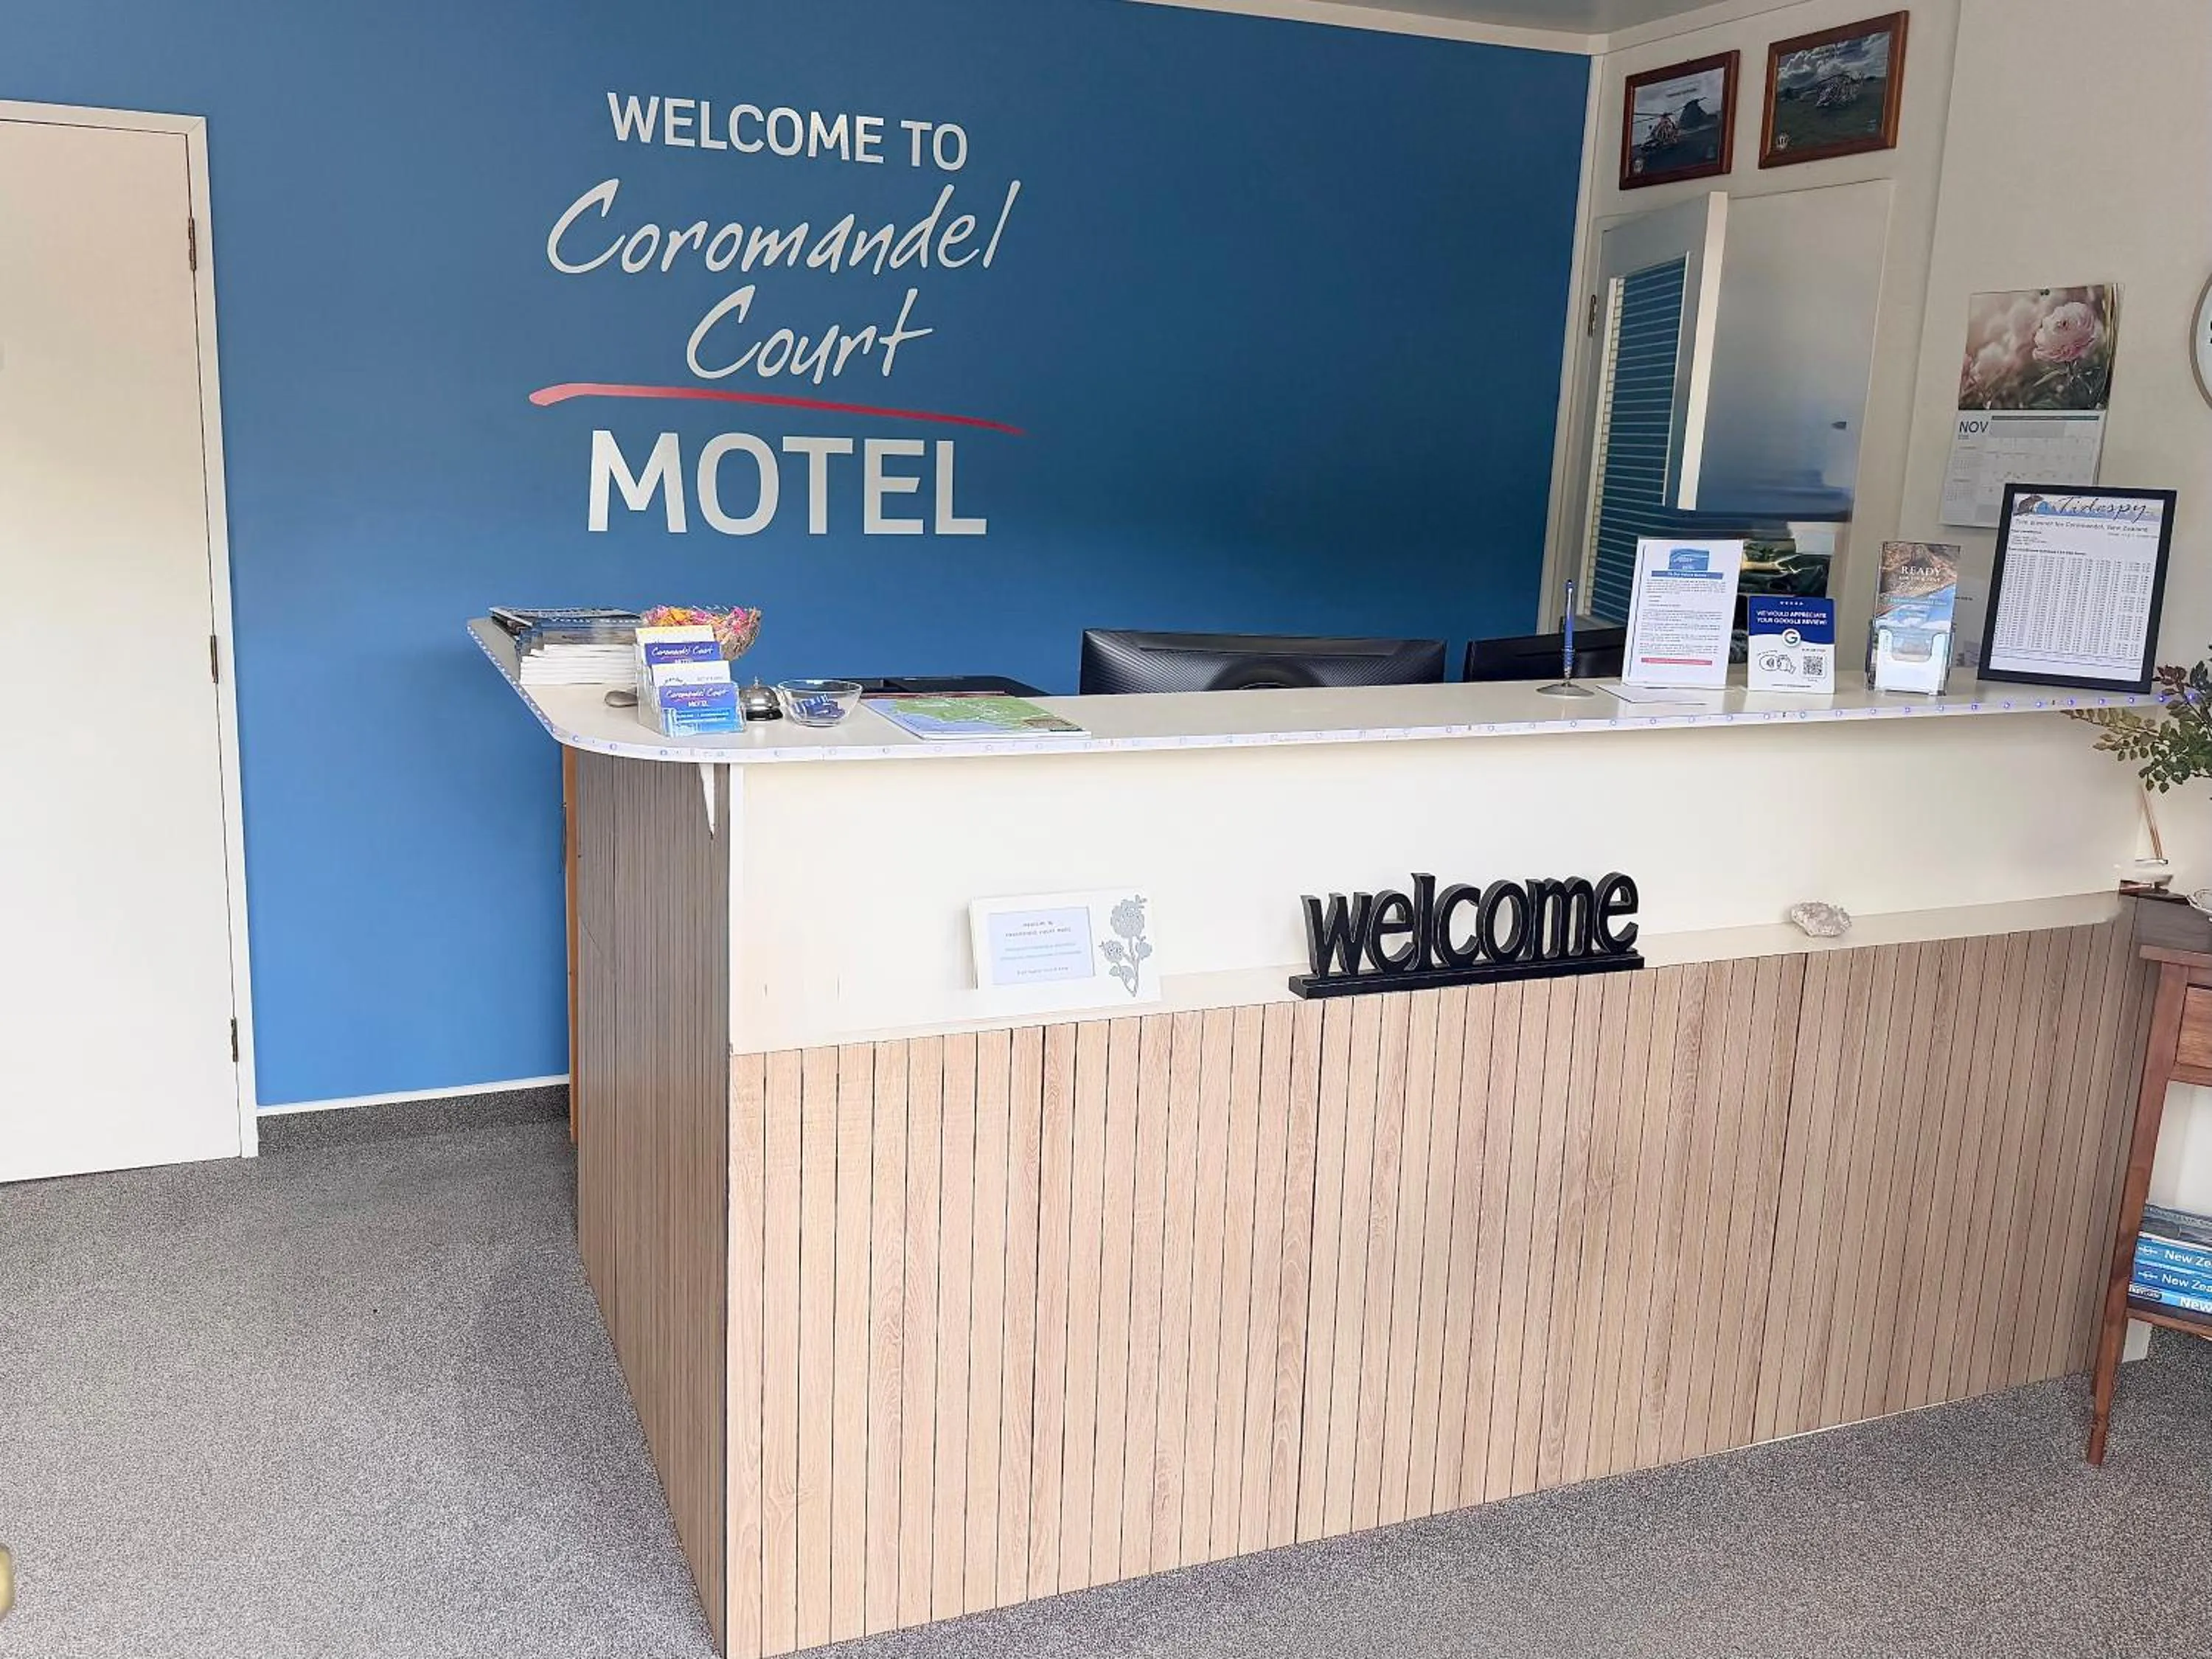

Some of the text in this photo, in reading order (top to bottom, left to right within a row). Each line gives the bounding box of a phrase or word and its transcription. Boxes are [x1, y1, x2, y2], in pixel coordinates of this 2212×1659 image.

[607, 91, 968, 171] WELCOME TO
[546, 178, 1020, 275] Coromandel
[686, 284, 933, 384] Court
[1959, 421, 1989, 433] NOV
[588, 429, 987, 535] MOTEL
[2059, 495, 2147, 524] Tidespy
[1902, 566, 1942, 576] READY
[1784, 630, 1798, 644] G
[1300, 871, 1640, 980] welcome
[2164, 1250, 2192, 1264] New
[2161, 1273, 2188, 1287] New
[2180, 1297, 2212, 1312] New
